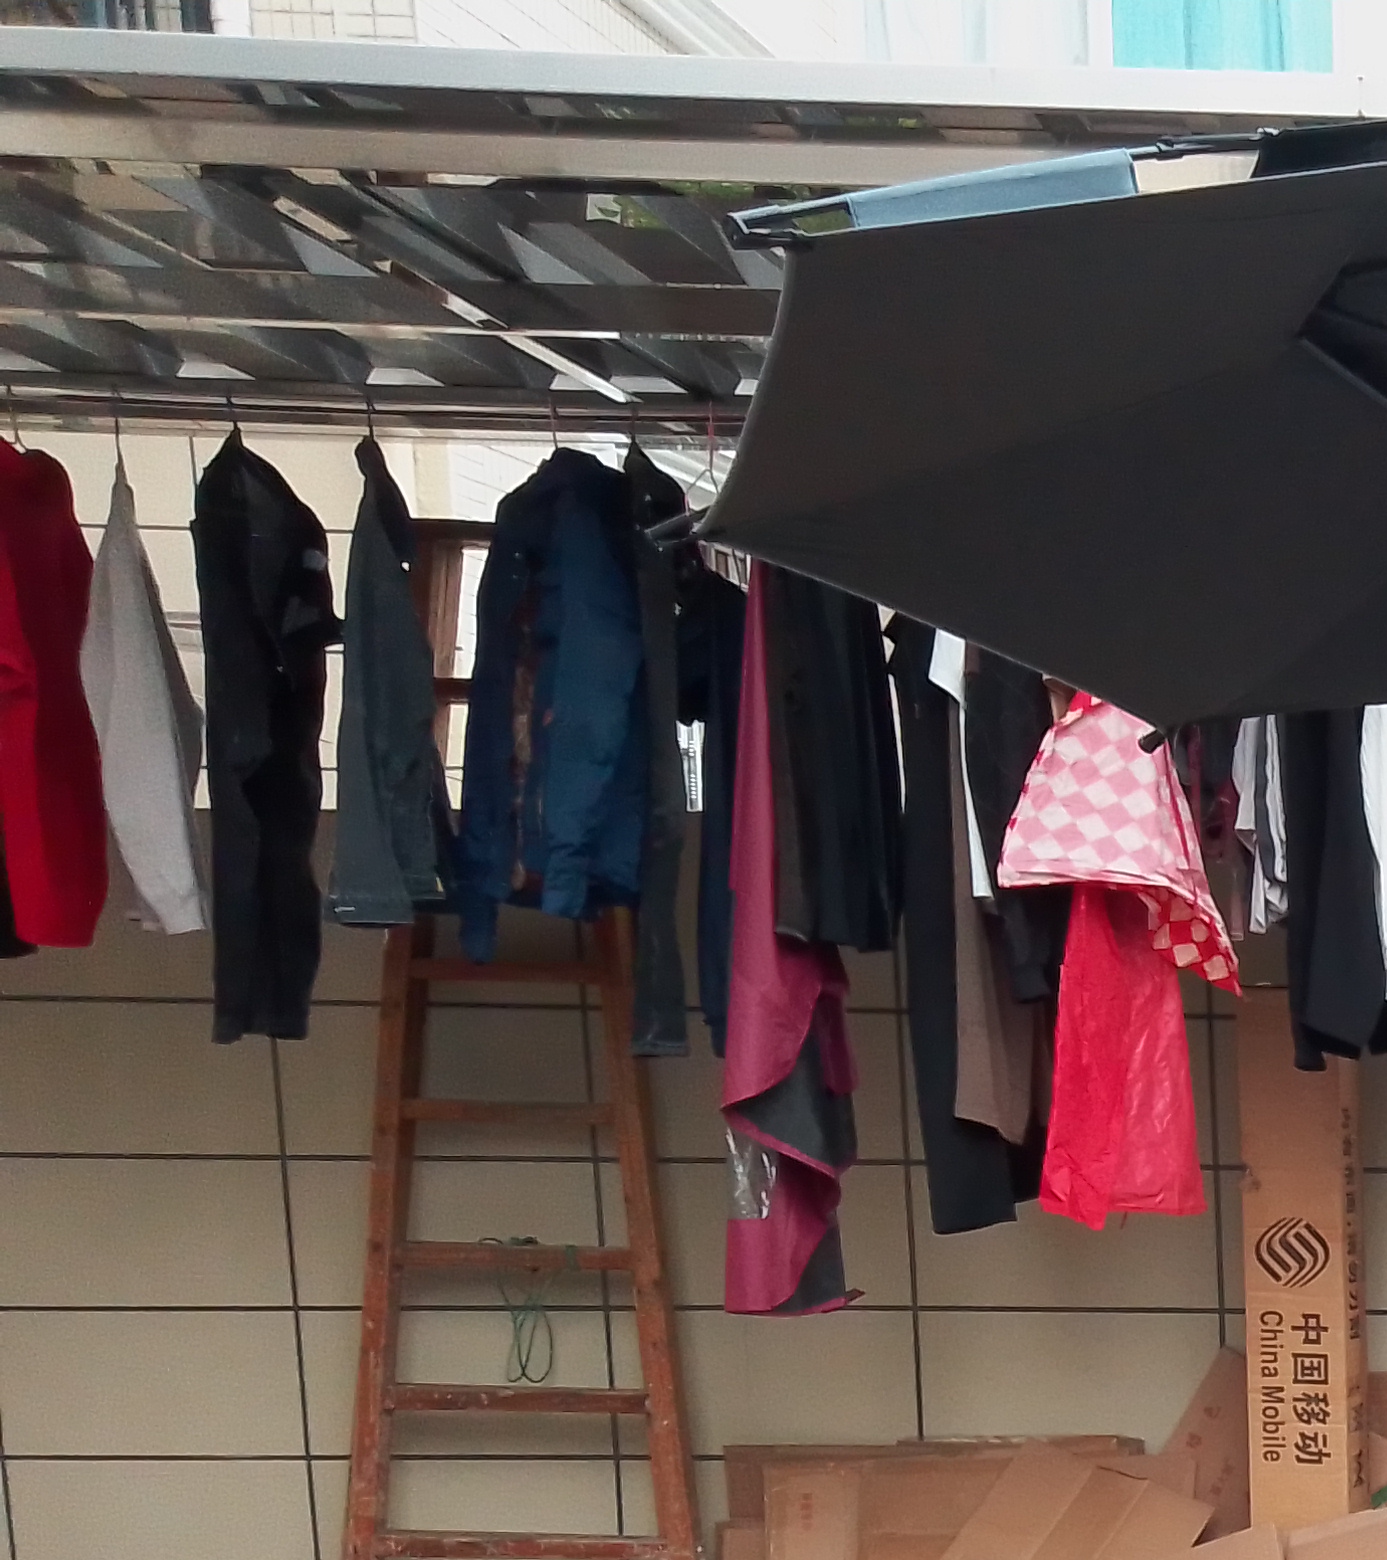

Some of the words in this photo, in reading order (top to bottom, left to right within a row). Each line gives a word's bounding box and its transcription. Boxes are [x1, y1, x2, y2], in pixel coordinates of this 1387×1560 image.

[1260, 1310, 1285, 1378] China
[1261, 1386, 1287, 1462] Mobile
[1290, 1313, 1331, 1464] 中国移动
